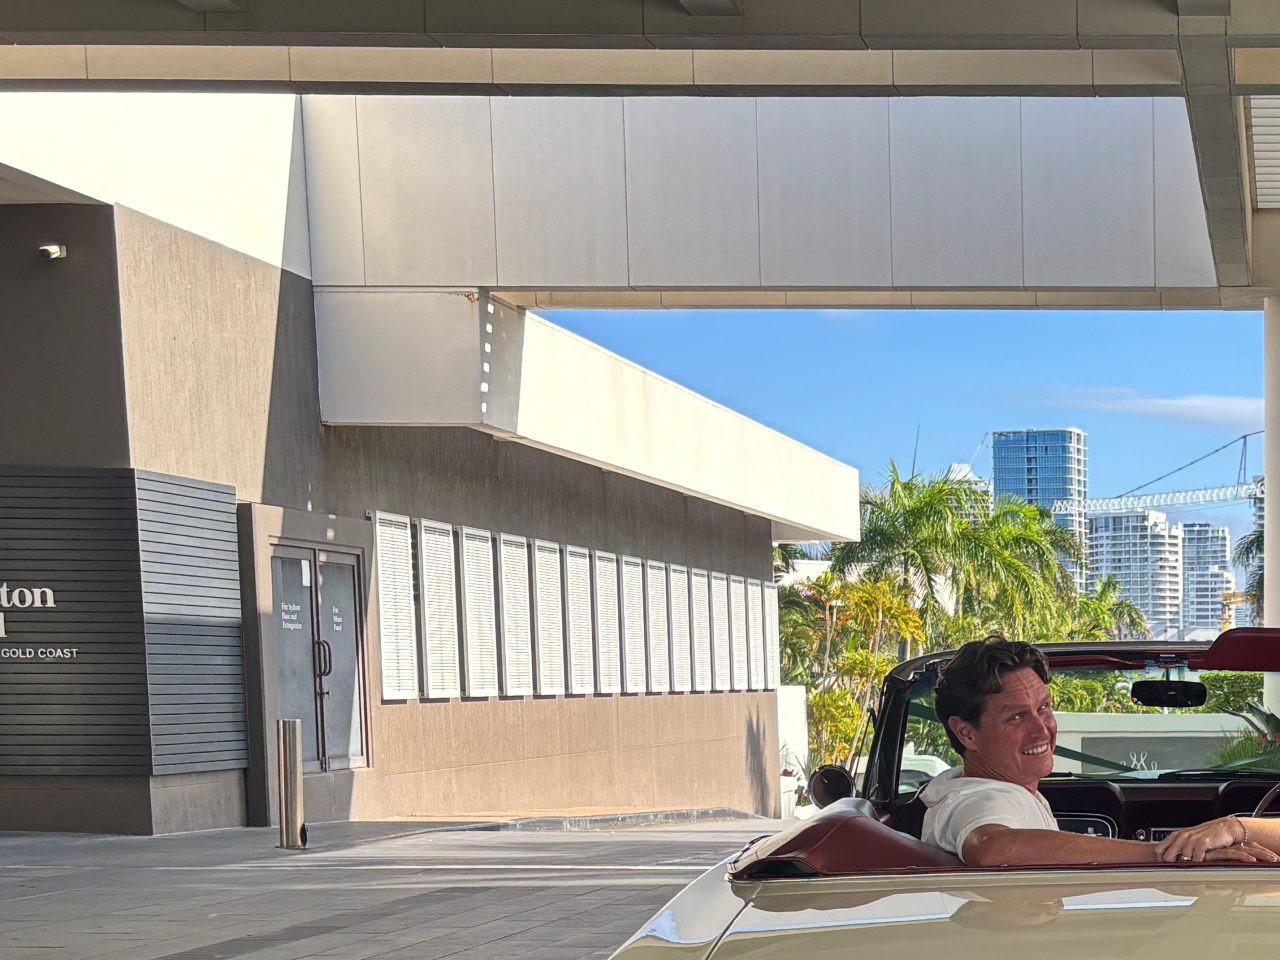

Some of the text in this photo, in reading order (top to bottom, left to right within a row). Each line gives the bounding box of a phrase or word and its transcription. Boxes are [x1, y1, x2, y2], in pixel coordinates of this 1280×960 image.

[0, 581, 57, 608] ton
[1, 648, 79, 658] GOLD COAST
